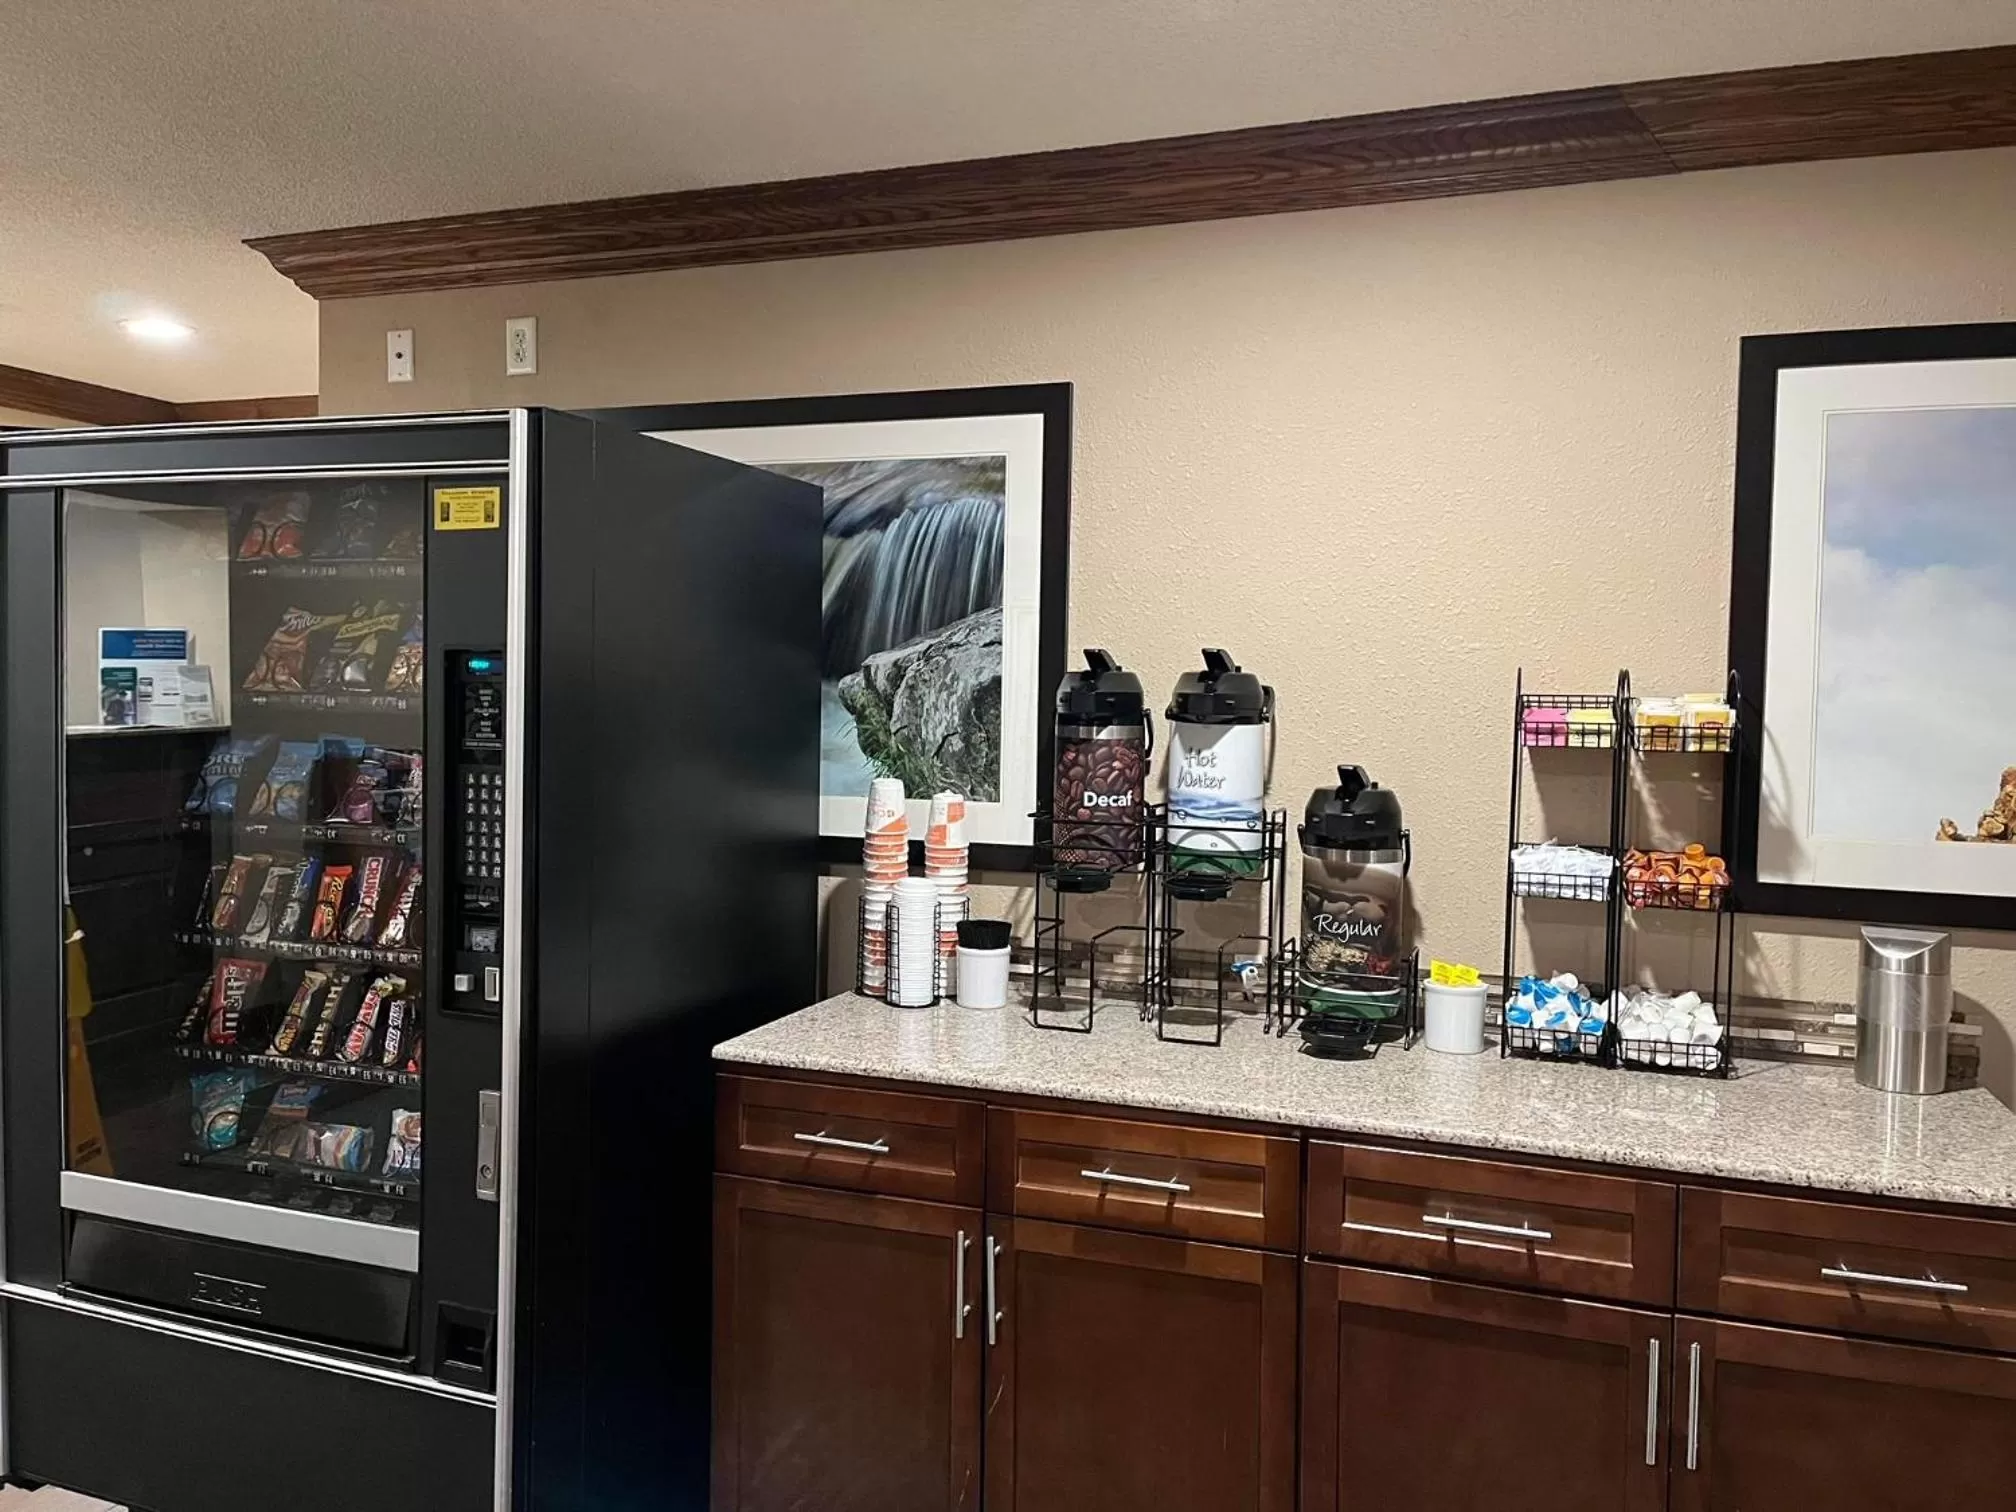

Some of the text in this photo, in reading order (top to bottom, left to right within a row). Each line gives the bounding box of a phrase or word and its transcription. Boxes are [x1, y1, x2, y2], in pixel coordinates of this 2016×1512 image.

[1184, 748, 1218, 768] Hot
[1177, 766, 1226, 788] Water
[1083, 790, 1133, 807] Decaf
[1313, 913, 1383, 942] Regular
